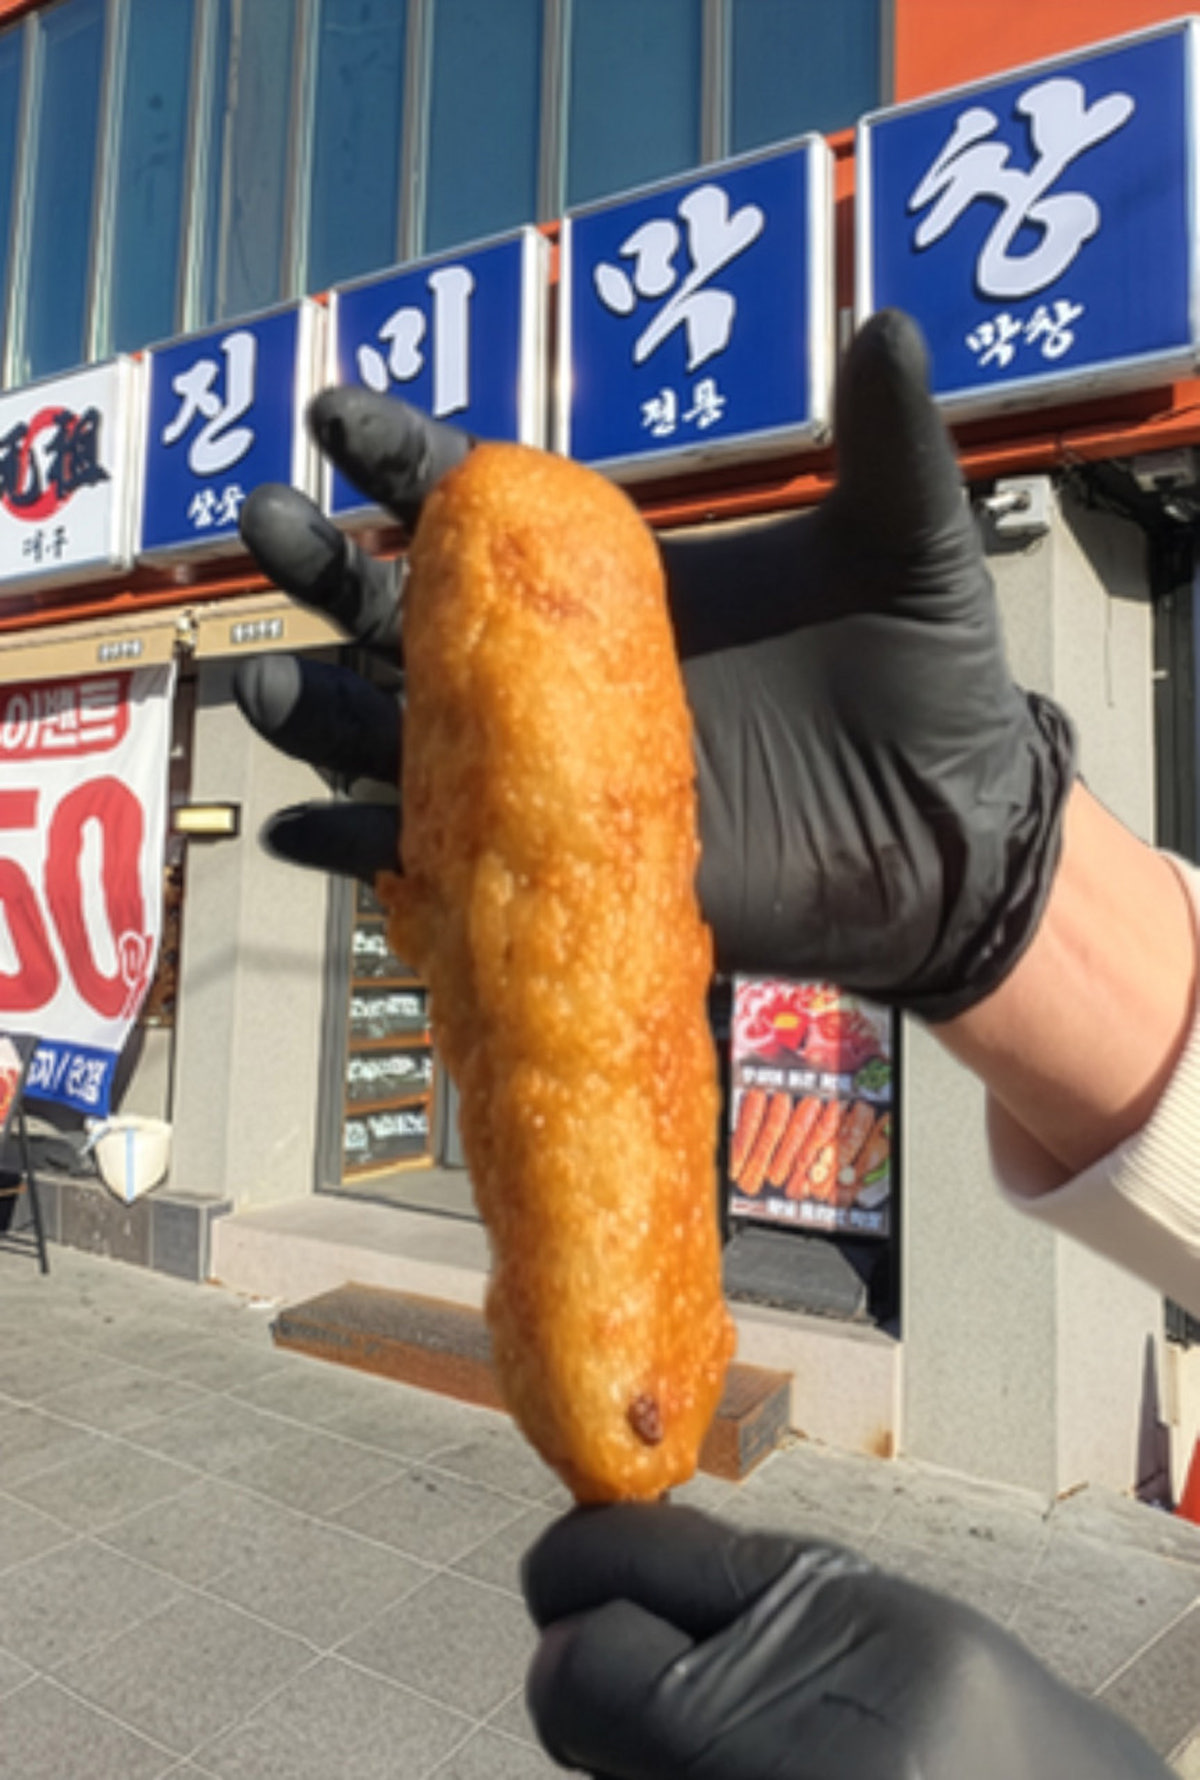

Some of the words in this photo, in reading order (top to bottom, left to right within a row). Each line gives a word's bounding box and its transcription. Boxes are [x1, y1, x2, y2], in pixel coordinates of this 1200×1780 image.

[161, 331, 256, 476] 진
[594, 184, 765, 372] 막
[966, 300, 1084, 368] 막창
[2, 679, 119, 749] 이벤트
